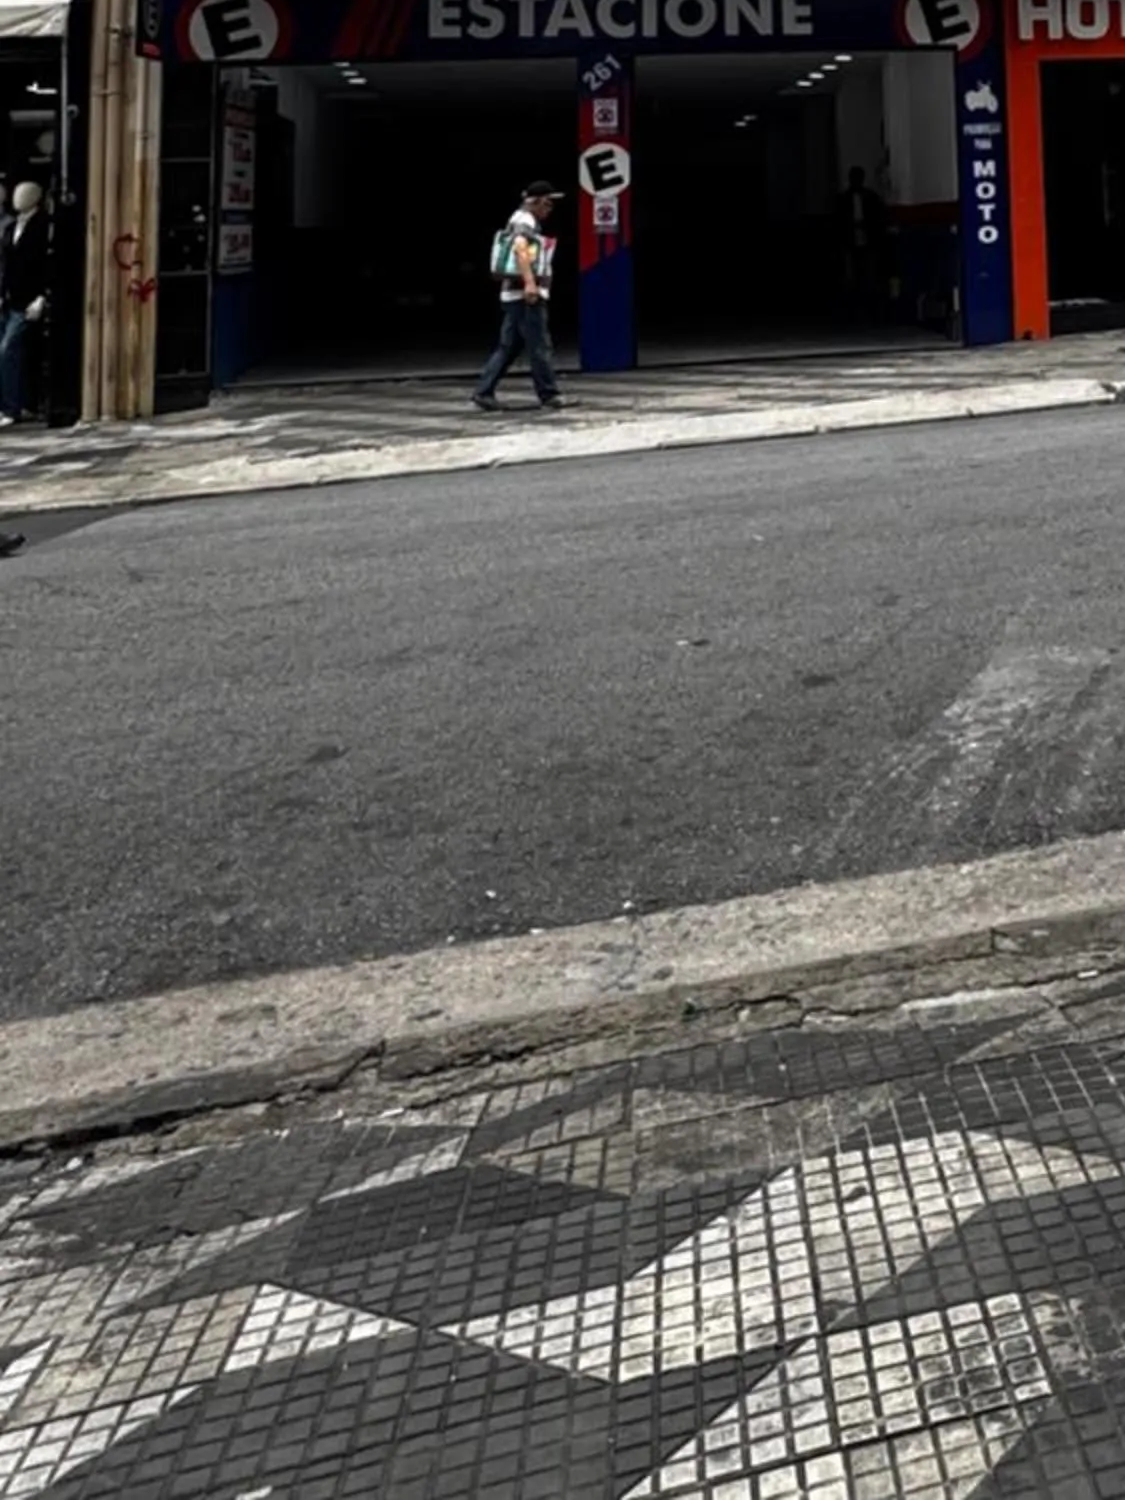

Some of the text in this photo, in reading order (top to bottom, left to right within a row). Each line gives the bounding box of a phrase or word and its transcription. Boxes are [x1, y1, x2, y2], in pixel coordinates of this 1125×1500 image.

[582, 53, 622, 92] 261
[585, 148, 625, 192] E
[973, 159, 998, 244] MOTO
